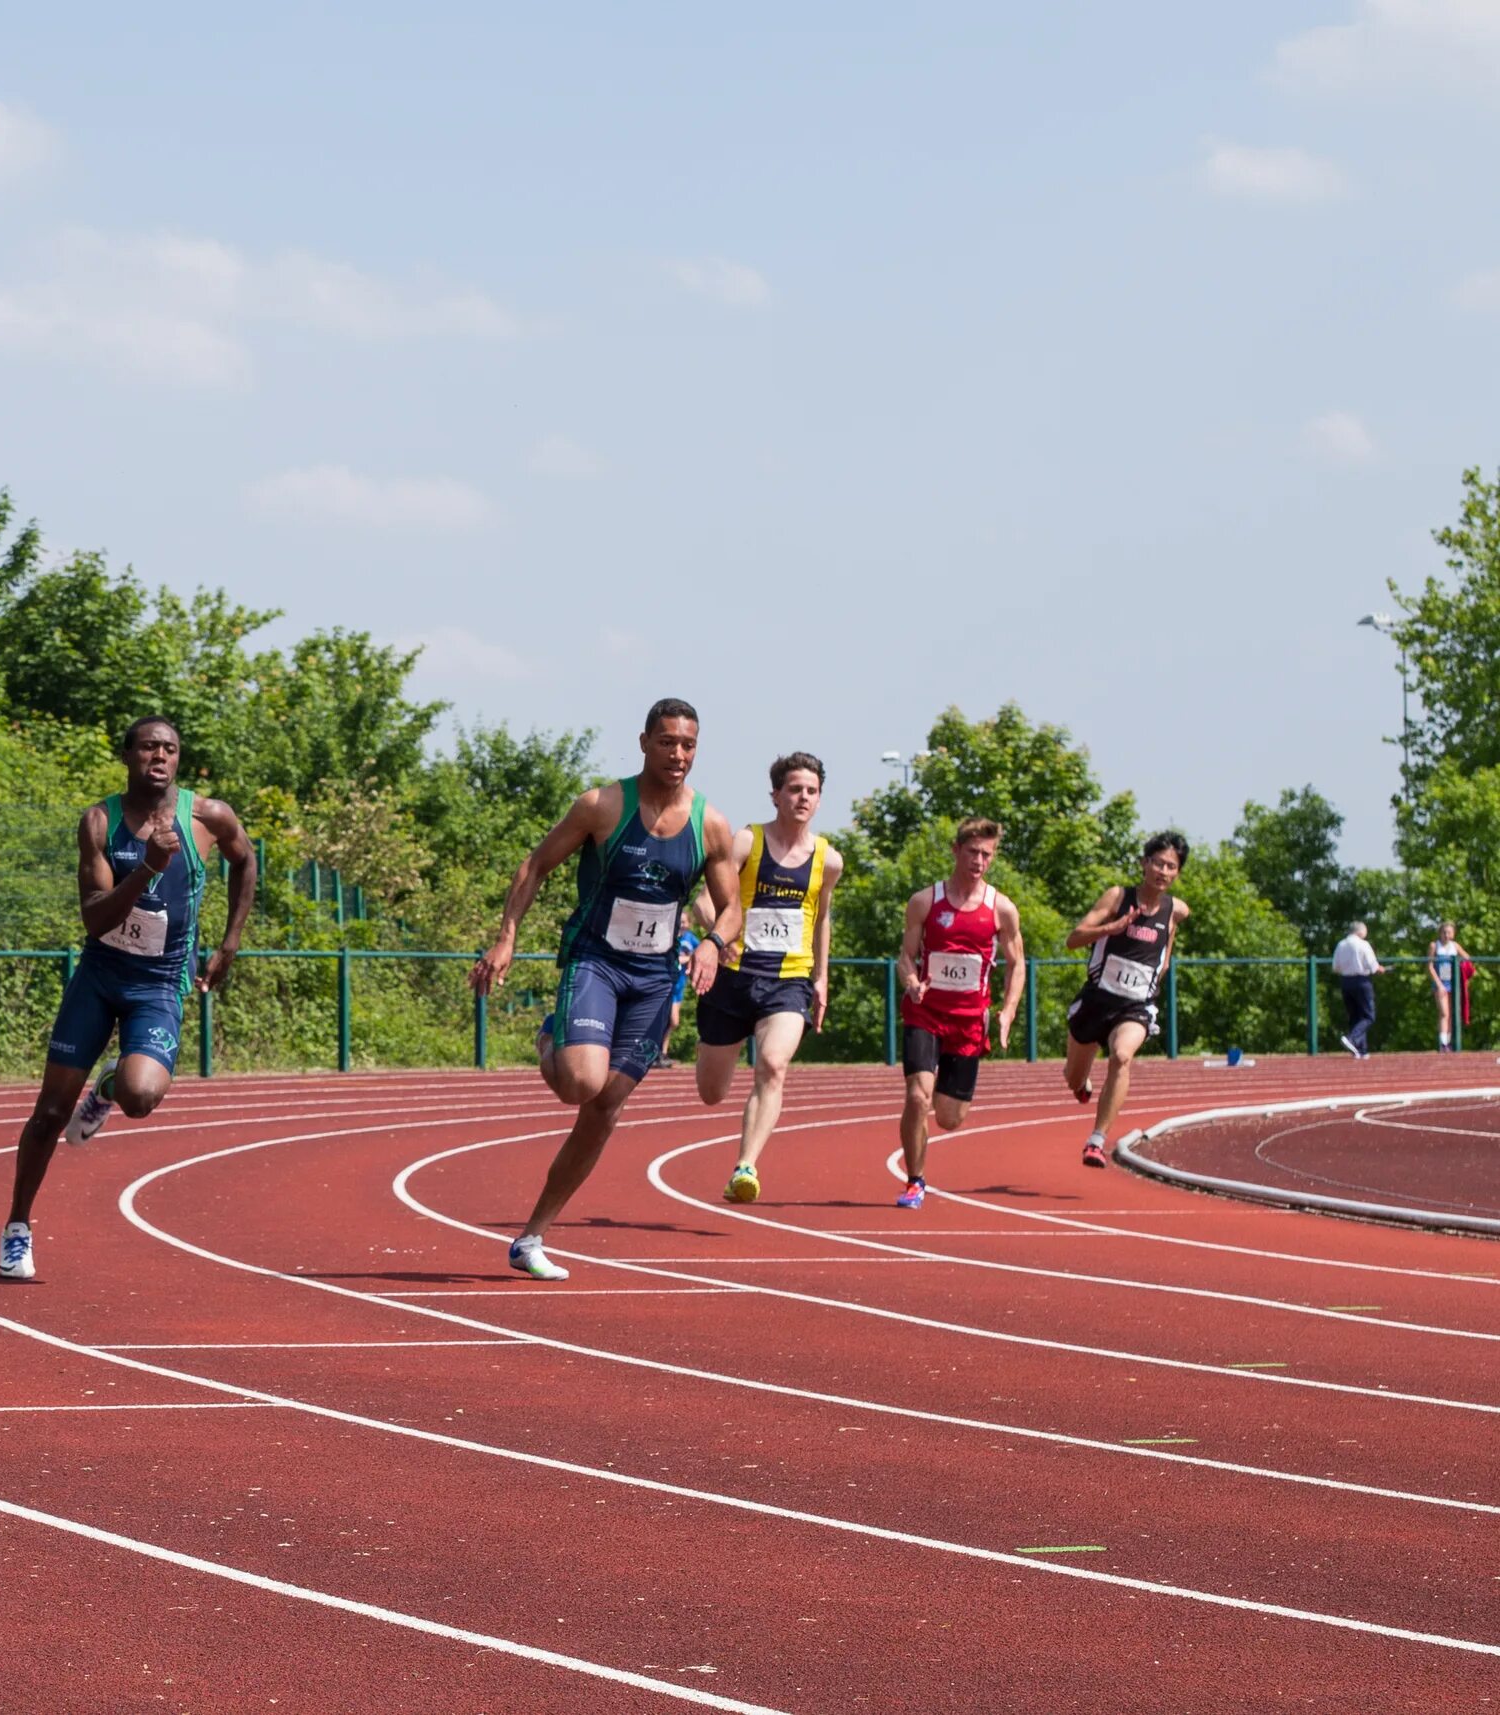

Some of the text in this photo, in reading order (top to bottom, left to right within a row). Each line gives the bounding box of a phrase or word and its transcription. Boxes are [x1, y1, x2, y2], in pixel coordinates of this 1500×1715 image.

[120, 920, 141, 939] 18
[634, 919, 657, 938] 14
[760, 922, 789, 938] 363
[941, 965, 967, 979] 463
[1116, 970, 1138, 987] 111
